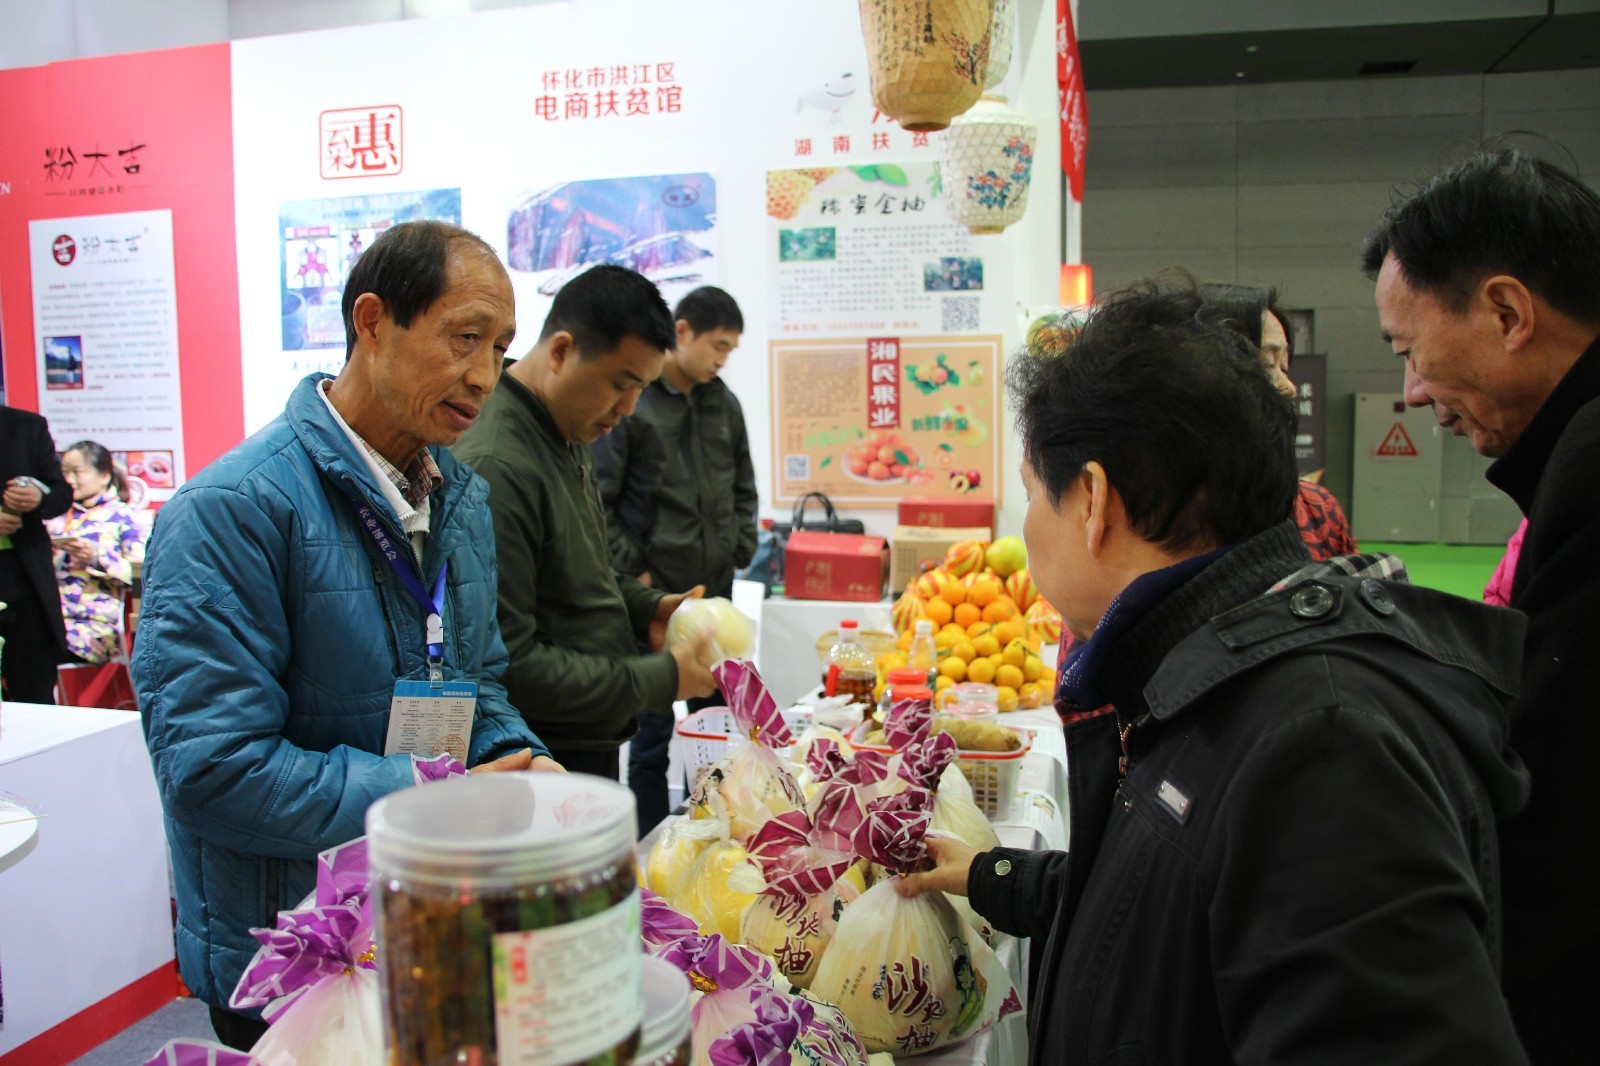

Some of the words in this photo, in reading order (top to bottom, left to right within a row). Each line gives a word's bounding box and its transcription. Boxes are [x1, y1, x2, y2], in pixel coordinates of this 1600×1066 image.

[541, 62, 676, 91] 怀化市洪江区
[534, 86, 683, 121] 电商扶贫馆
[43, 141, 147, 182] 粉大吉
[870, 341, 898, 427] 湘民果业
[359, 506, 397, 561] 农业博览会
